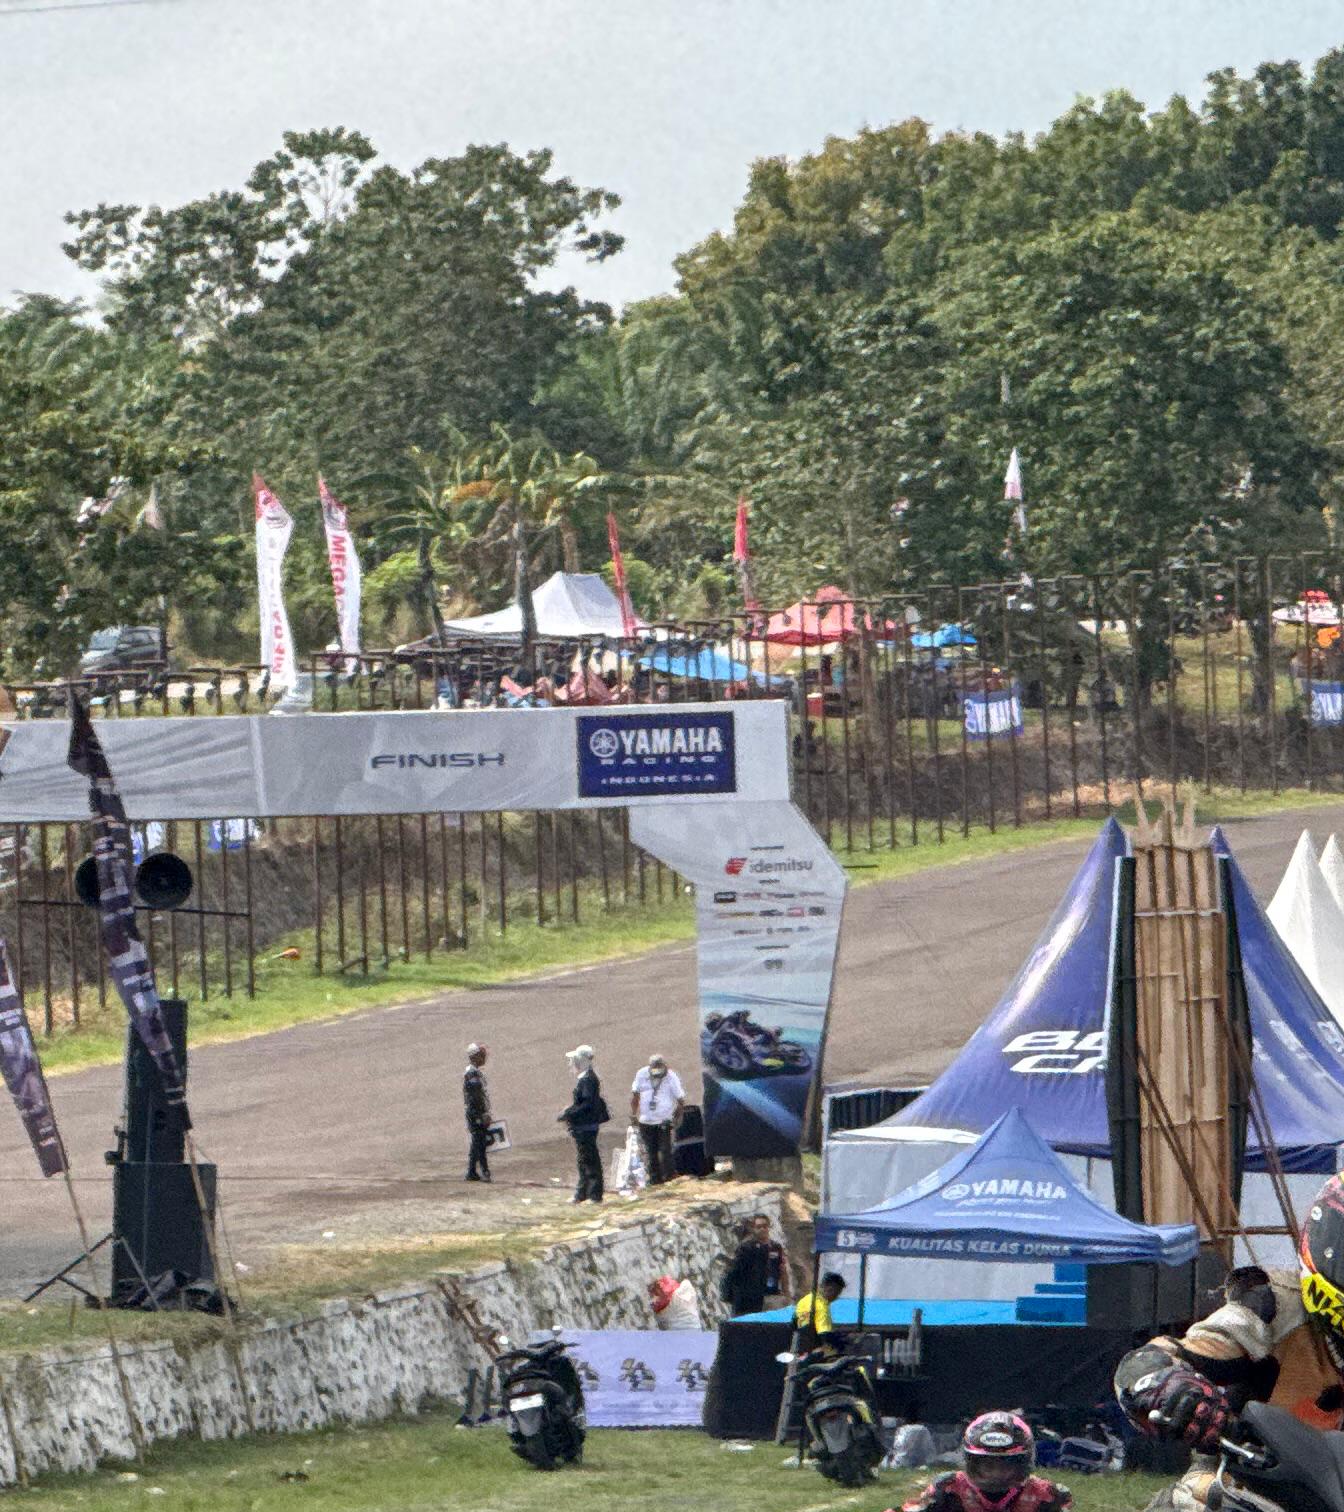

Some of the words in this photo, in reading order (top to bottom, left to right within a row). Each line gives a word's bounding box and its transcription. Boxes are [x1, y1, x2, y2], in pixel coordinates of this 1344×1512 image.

[620, 727, 723, 755] YAMAHA
[370, 751, 506, 769] FINISH
[600, 755, 716, 765] RACING
[749, 856, 814, 874] idemitsu
[972, 1179, 1069, 1201] YAMAHA
